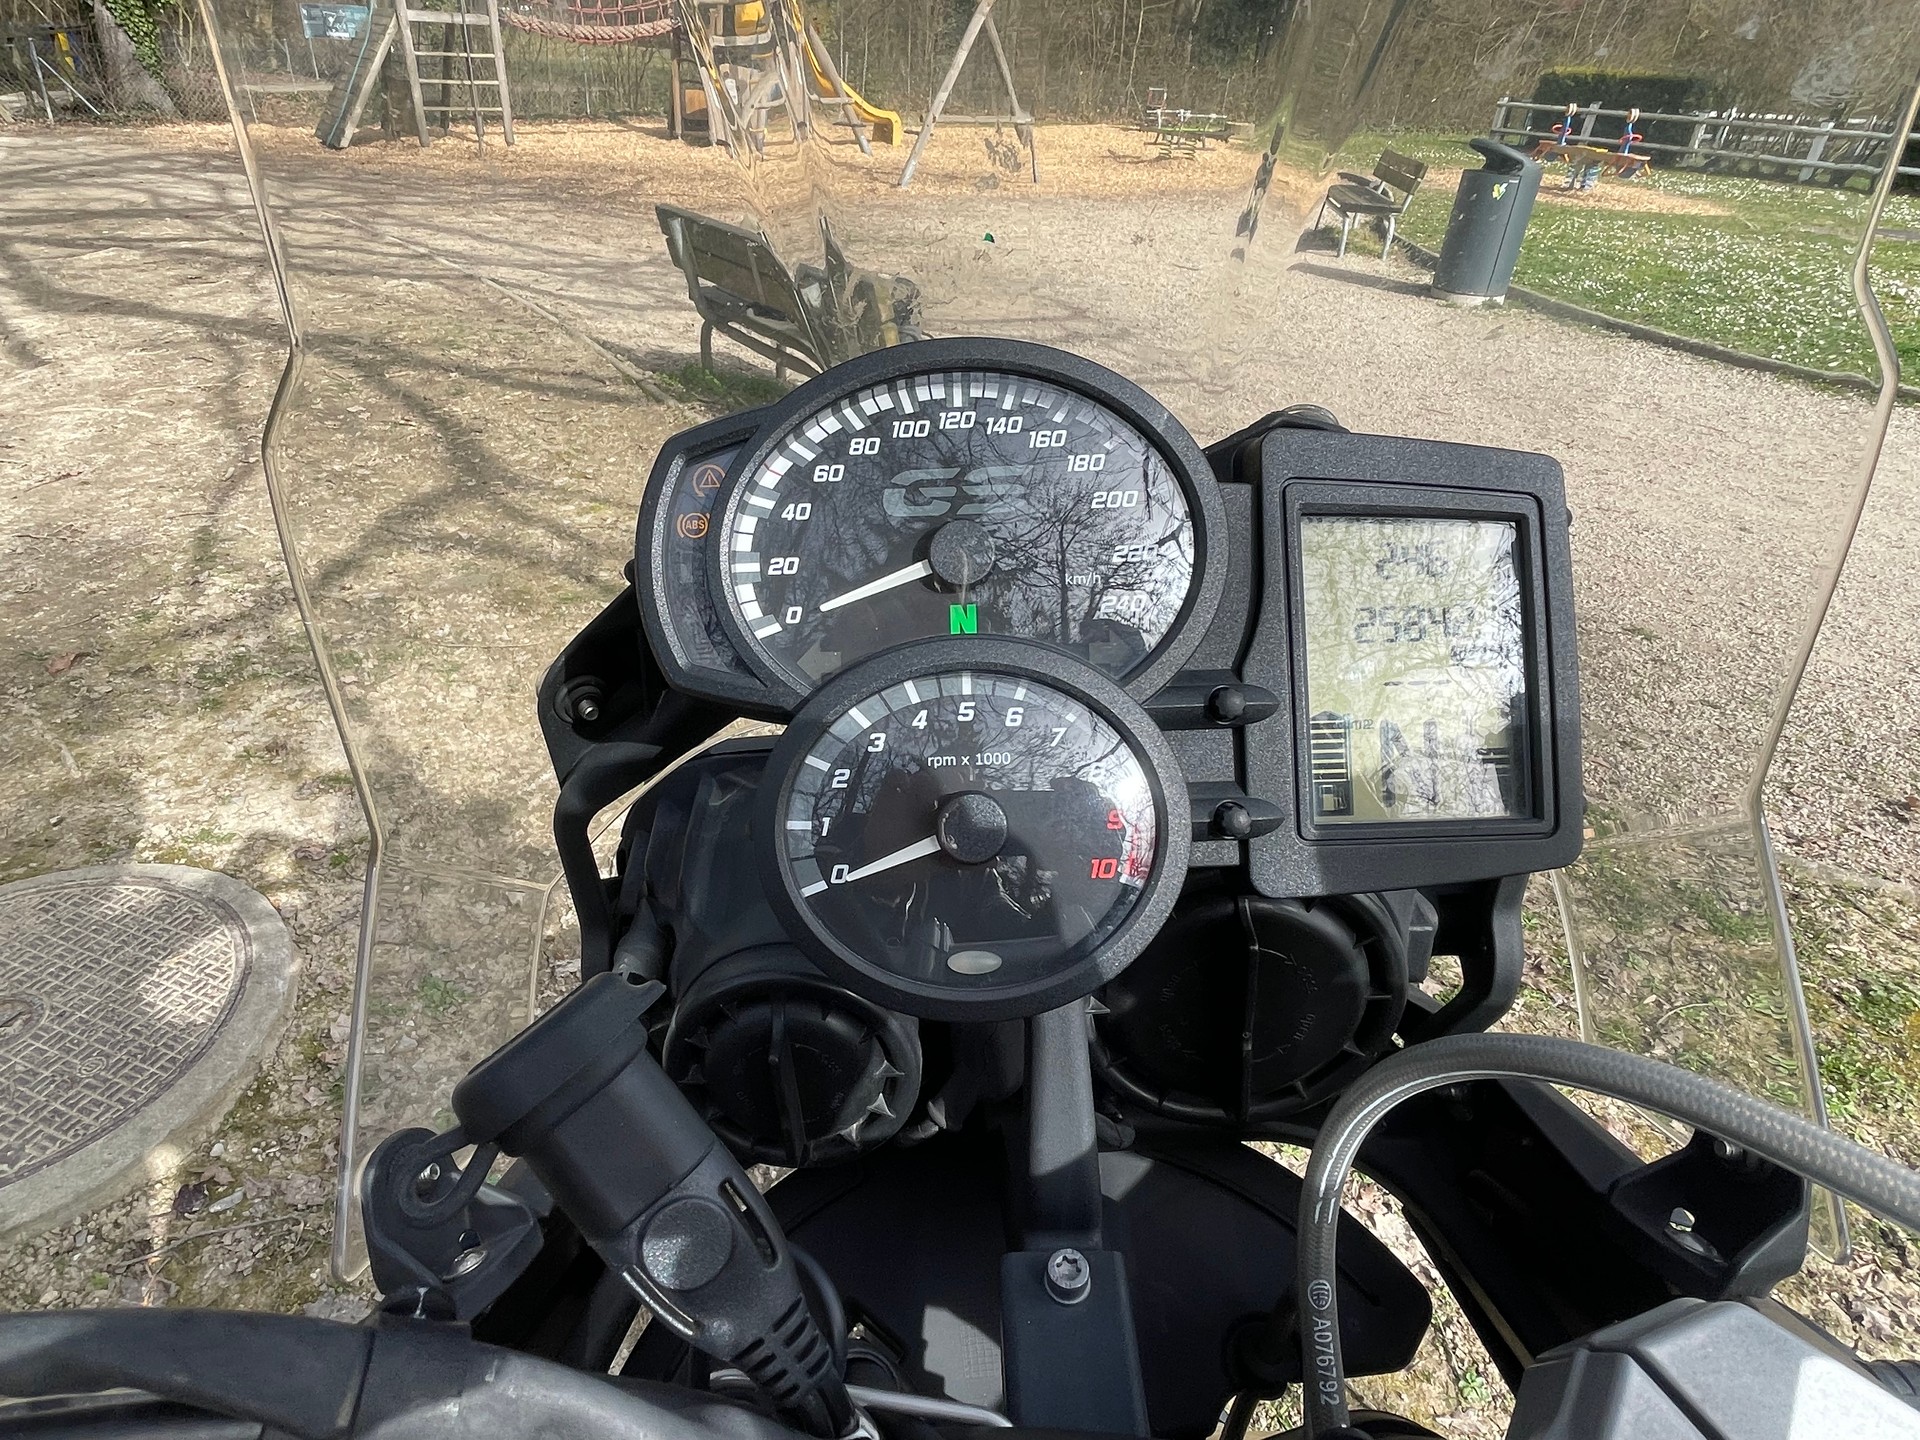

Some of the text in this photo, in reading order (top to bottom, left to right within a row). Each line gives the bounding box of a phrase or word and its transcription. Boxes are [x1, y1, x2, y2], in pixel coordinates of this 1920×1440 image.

[892, 420, 931, 438] 100
[938, 410, 976, 430] 120
[985, 416, 1023, 435] 140
[848, 437, 881, 456] 80
[1028, 429, 1067, 449] 160
[812, 463, 845, 482] 60
[1067, 453, 1106, 473] 180
[882, 465, 1034, 517] GS
[1091, 490, 1139, 509] 200
[781, 502, 812, 521] 40
[685, 518, 706, 531] ABS
[1112, 544, 1159, 563] 220
[767, 557, 800, 576] 20
[1065, 572, 1101, 586] km/h
[1100, 595, 1146, 613] 240
[784, 605, 803, 624] 0
[948, 604, 979, 635] N
[911, 709, 928, 730] 4
[957, 701, 976, 722] 5
[1005, 706, 1024, 727] 6
[867, 732, 886, 753] 3
[1051, 727, 1068, 748] 7
[927, 752, 1011, 769] rpm x 1000
[832, 768, 851, 788] 2
[820, 817, 831, 837] 1
[1106, 809, 1123, 830] 9
[830, 864, 850, 885] 0
[1090, 857, 1118, 879] 10
[1312, 1316, 1340, 1406] A076792
